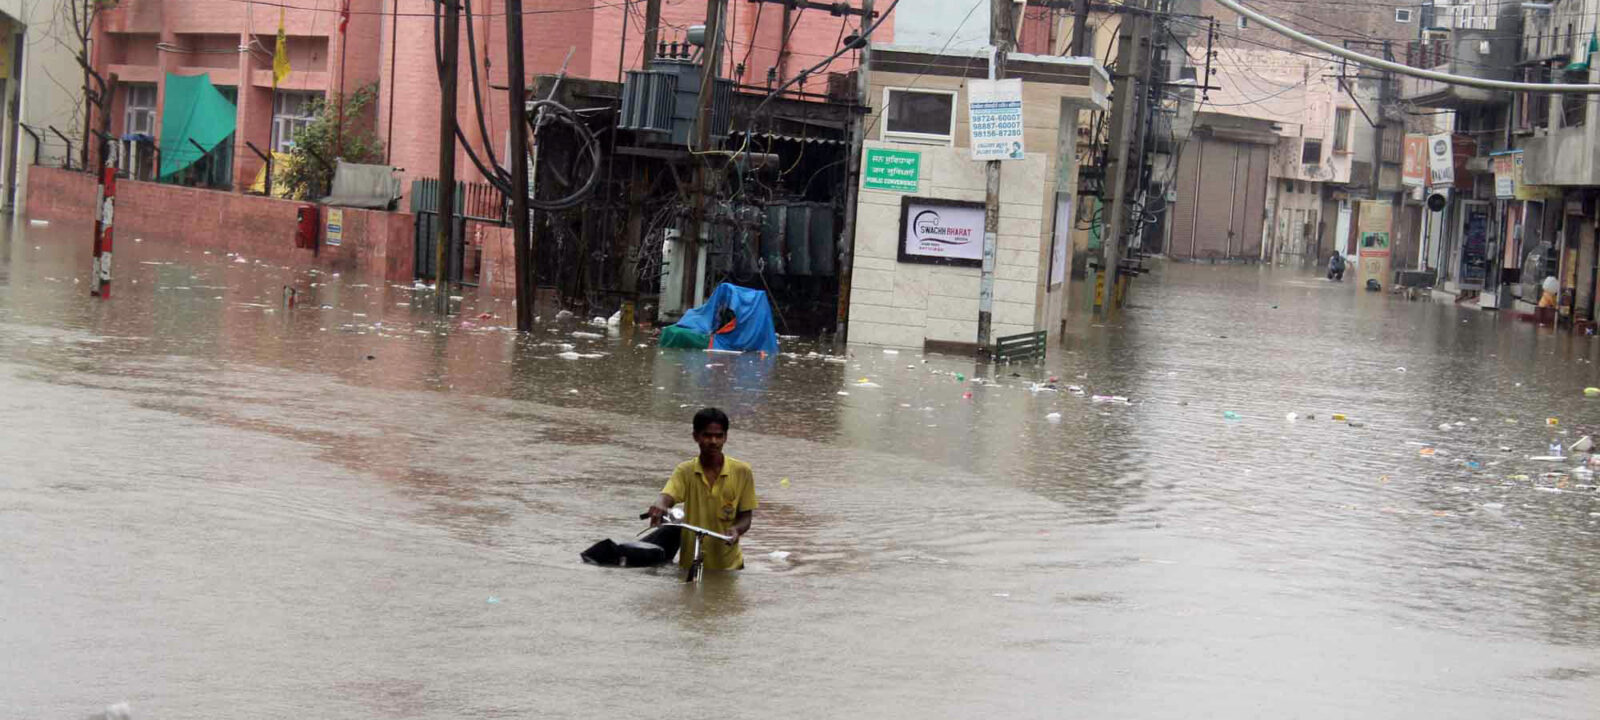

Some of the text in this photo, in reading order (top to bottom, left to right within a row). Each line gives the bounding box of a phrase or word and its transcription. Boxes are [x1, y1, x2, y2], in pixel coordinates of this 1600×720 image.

[866, 176, 917, 186] PUBLIC CONVENIENCE
[920, 225, 972, 237] SWACHH BHARAT
